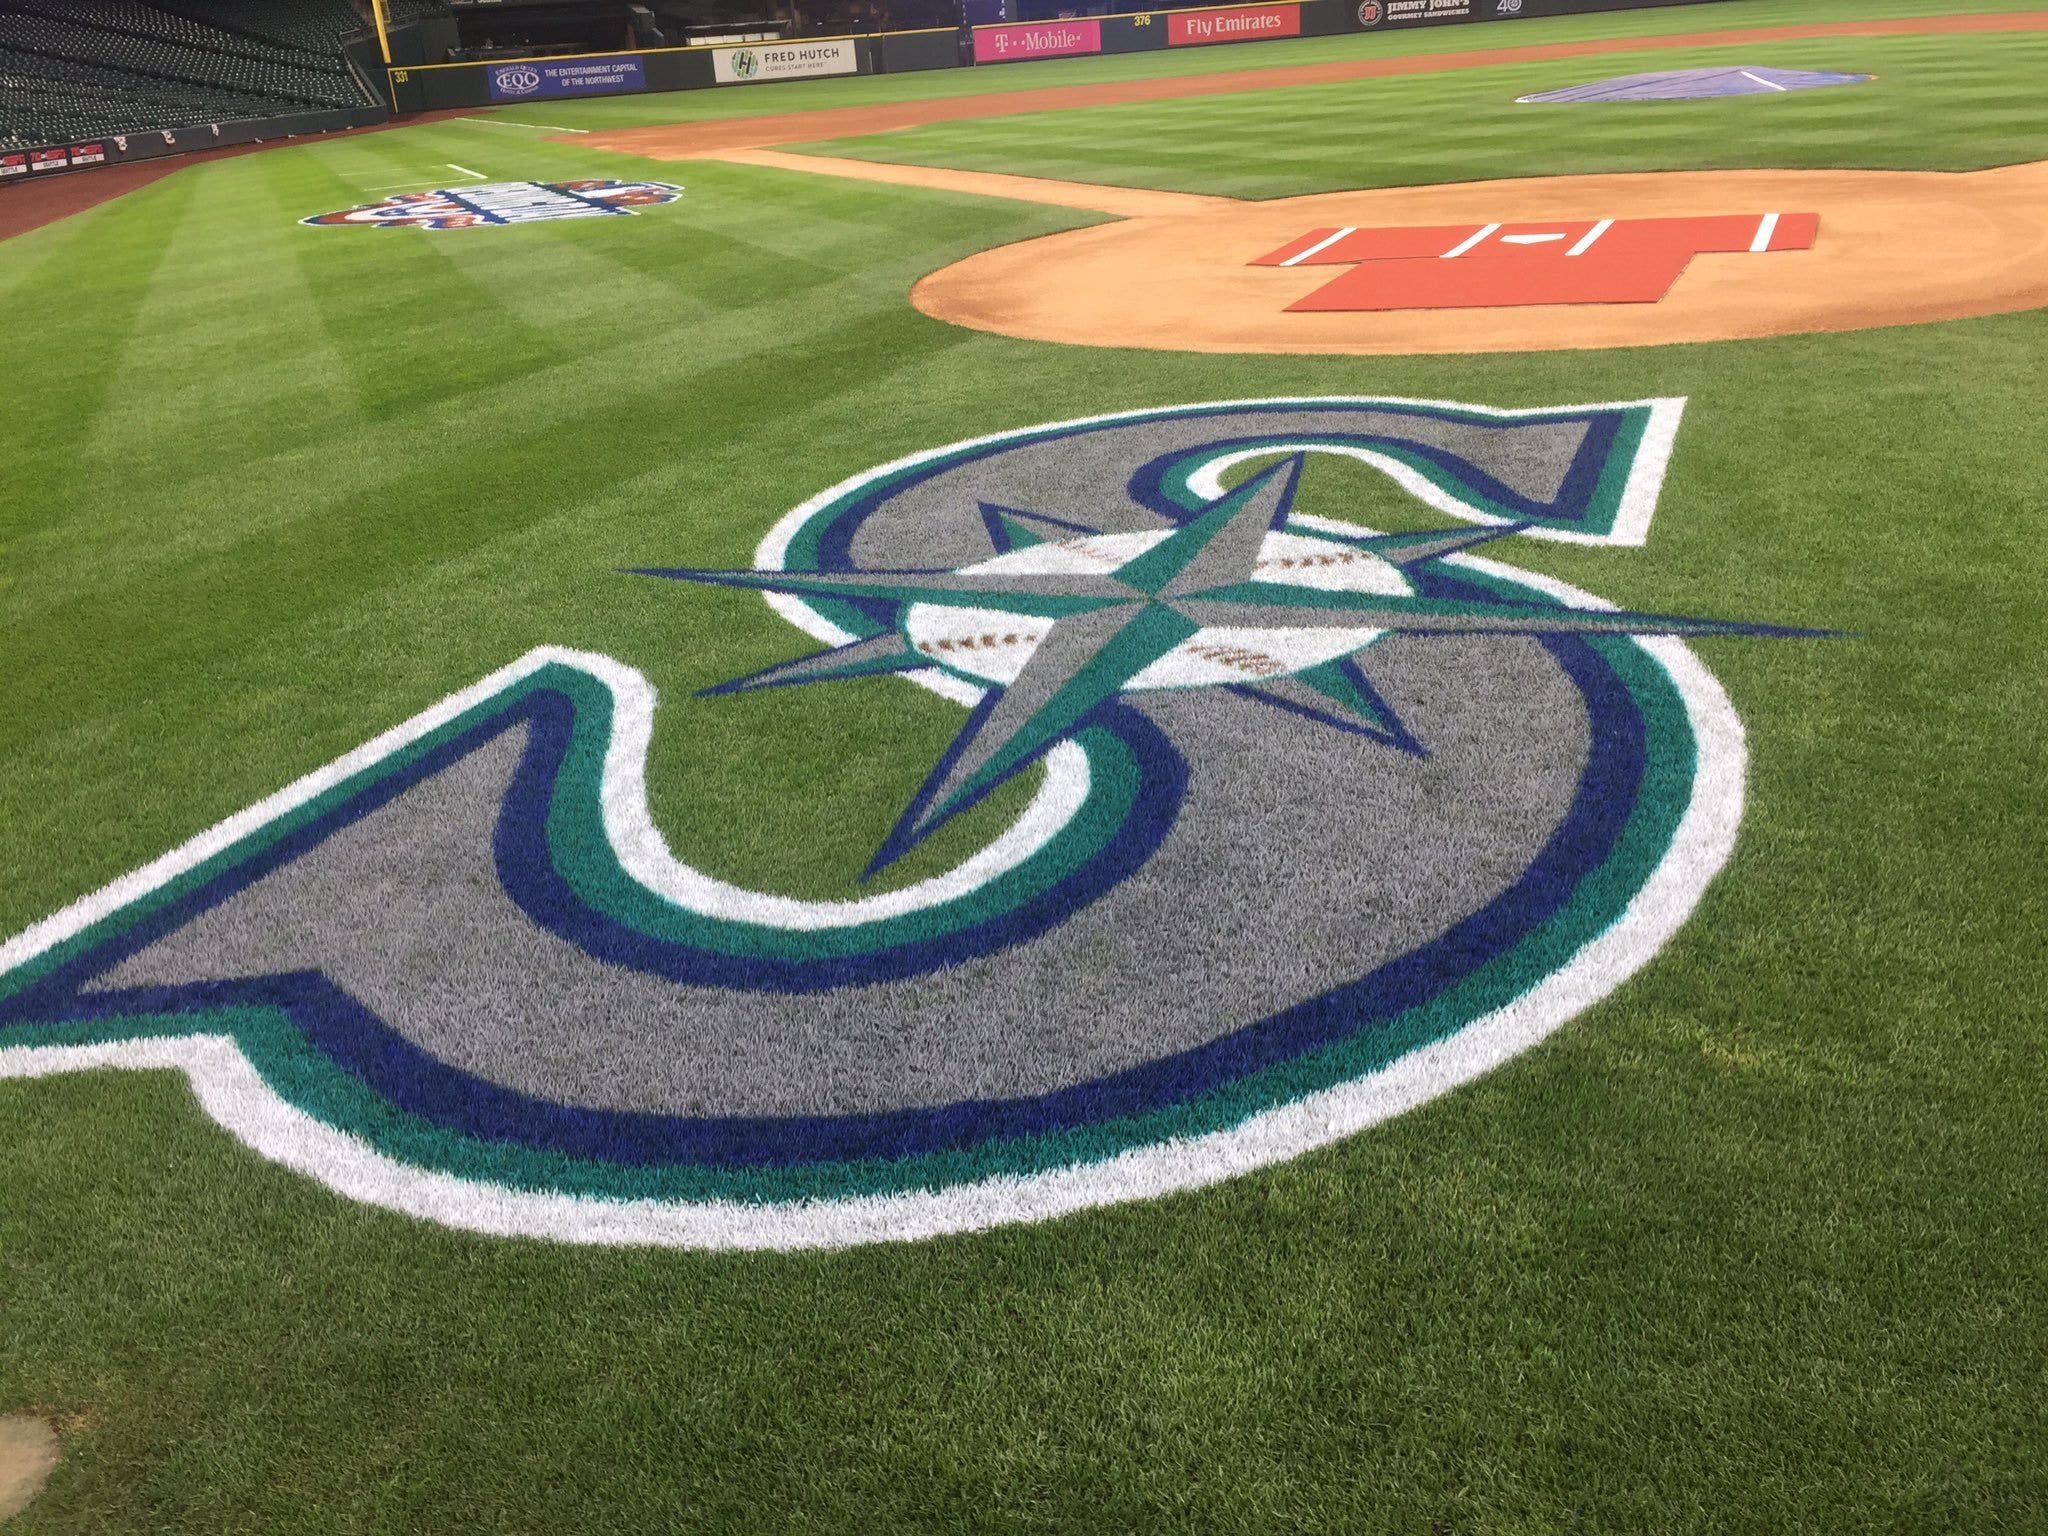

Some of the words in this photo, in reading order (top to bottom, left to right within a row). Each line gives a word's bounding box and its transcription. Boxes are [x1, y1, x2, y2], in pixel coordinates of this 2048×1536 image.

[1387, 0, 1427, 14] JIMMY
[1429, 0, 1470, 11] JOHN'S
[1387, 12, 1423, 21] GOURMET
[1423, 7, 1470, 18] SANDWICHES
[1134, 14, 1152, 27] 376
[1186, 18, 1213, 37] Fly
[1215, 14, 1282, 33] Emirates
[764, 51, 796, 63] FRED
[799, 48, 840, 61] HUTCH
[544, 68, 558, 78] THE
[558, 64, 612, 76] ENTERTAINMENT
[611, 63, 638, 73] CAPITAL
[765, 64, 787, 72] CURES
[787, 63, 806, 71] START
[394, 70, 409, 83] 331
[502, 71, 540, 90] EQC
[561, 78, 571, 87] OF
[571, 77, 585, 86] THE
[585, 75, 624, 85] NORTHWEST
